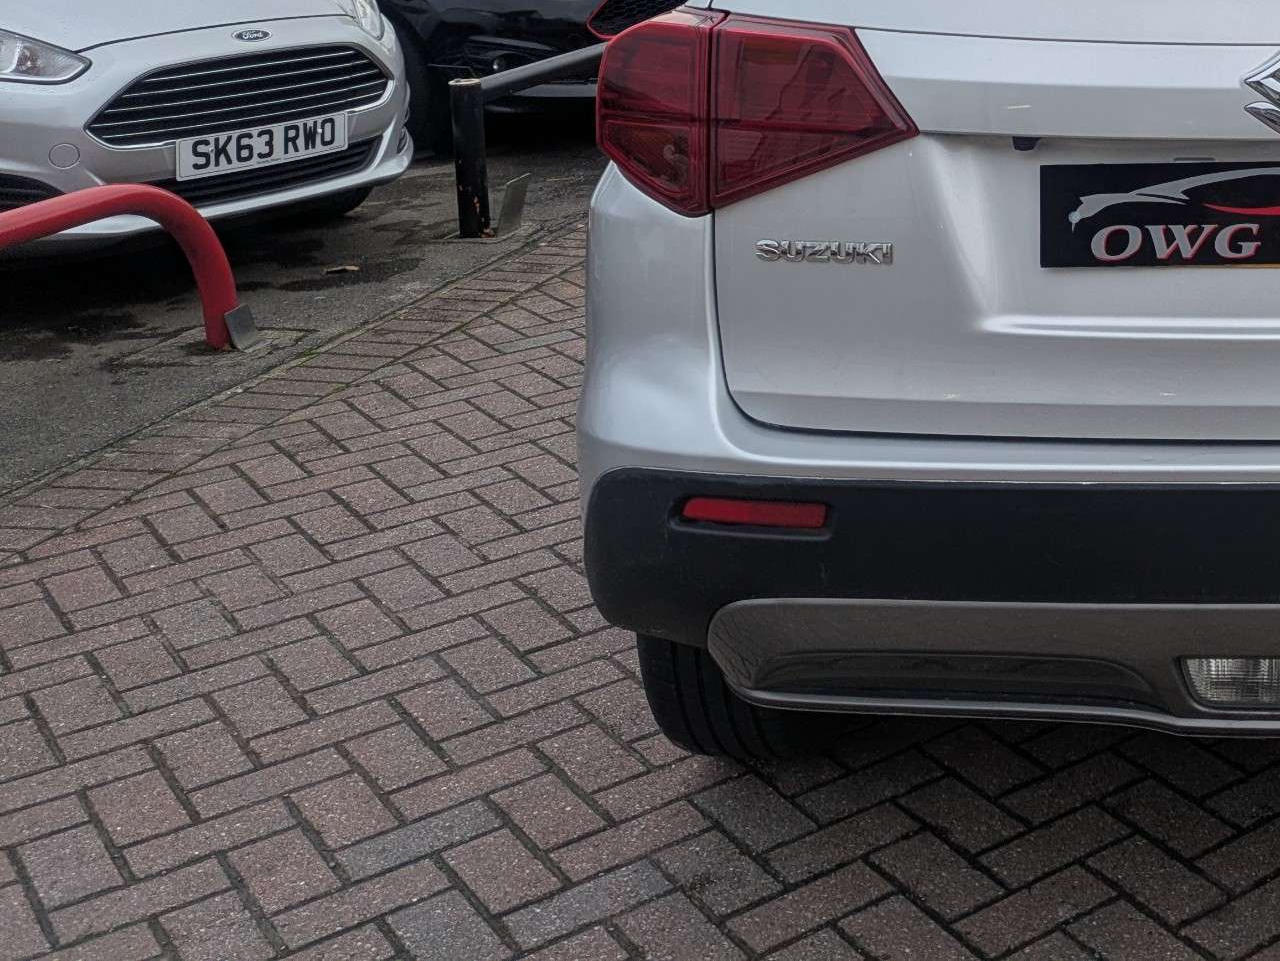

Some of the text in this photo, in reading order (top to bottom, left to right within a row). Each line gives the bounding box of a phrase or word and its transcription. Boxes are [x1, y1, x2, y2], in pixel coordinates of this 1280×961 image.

[191, 117, 336, 171] SK63 RWO
[755, 239, 893, 265] SUZUKI
[1090, 222, 1262, 262] OWG
